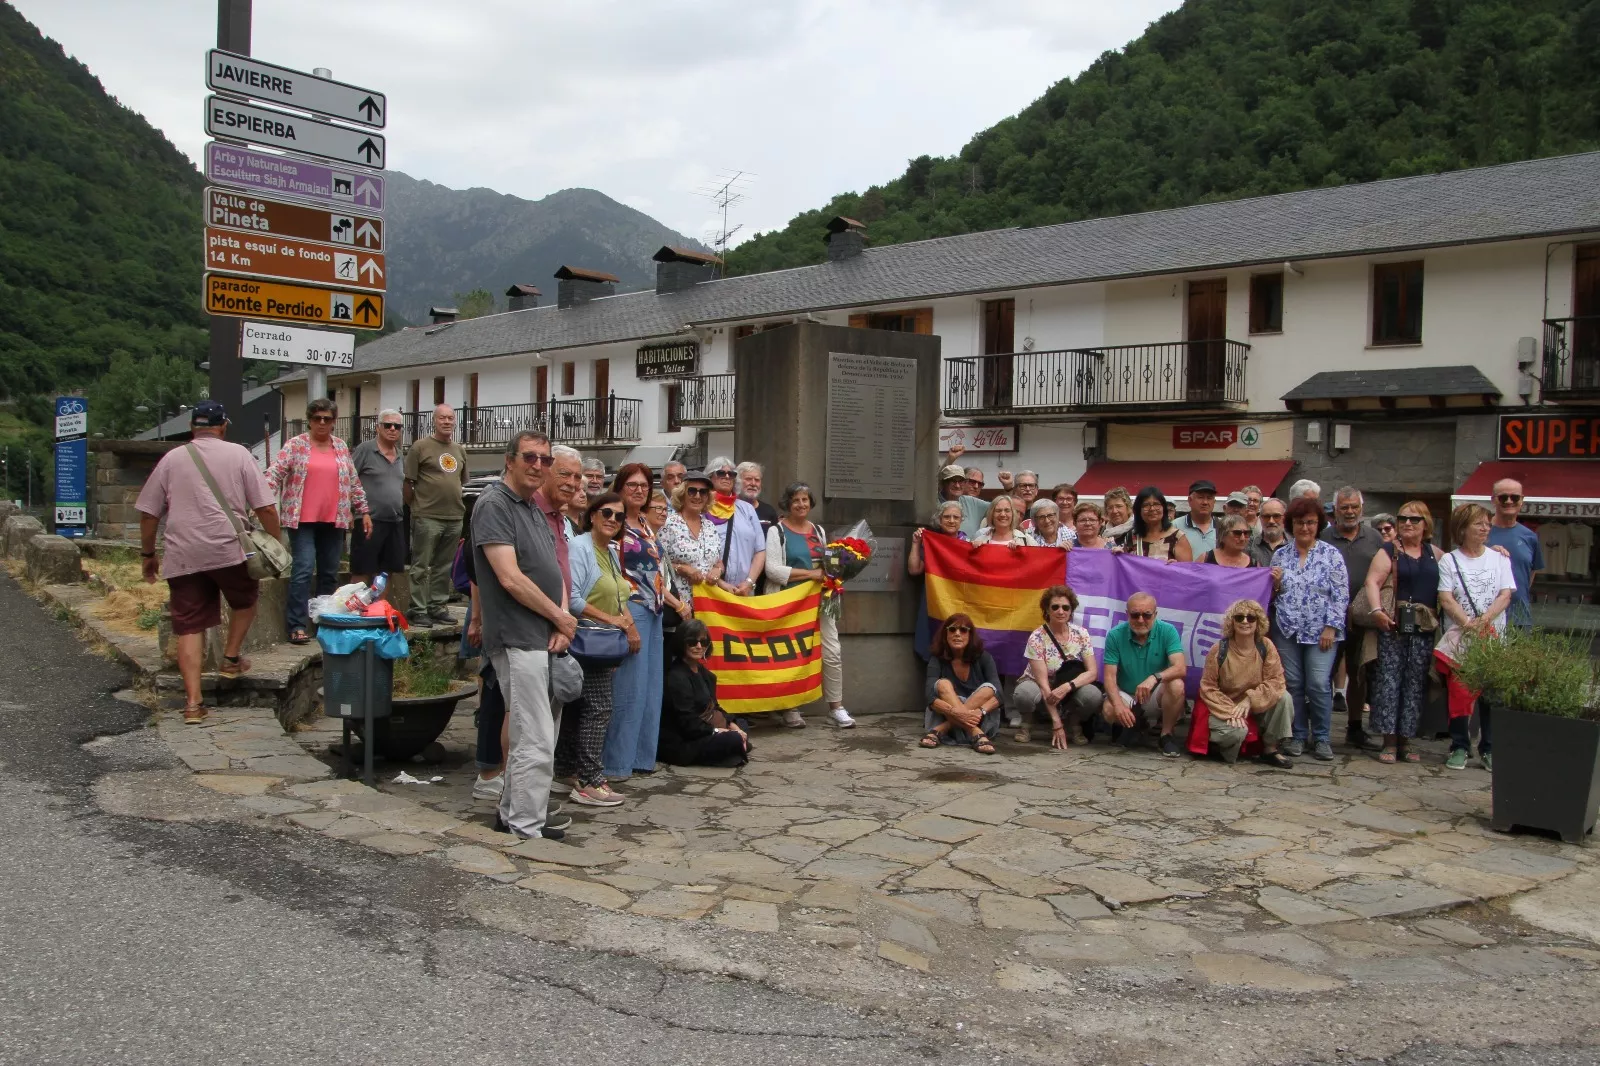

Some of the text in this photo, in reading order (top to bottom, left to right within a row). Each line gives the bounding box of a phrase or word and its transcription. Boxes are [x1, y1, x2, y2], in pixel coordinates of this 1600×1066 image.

[216, 63, 292, 95] JAVIERRE
[214, 108, 296, 140] ESPIERBA
[214, 150, 297, 175] Arte y Naturaleza
[214, 165, 329, 195] Escultura Siajh Armajani
[213, 193, 265, 212] Valle de
[212, 207, 269, 230] Pineta
[210, 235, 240, 249] pista
[281, 246, 295, 256] de
[299, 248, 331, 262] fondo
[210, 250, 251, 266] 14 Km
[212, 280, 260, 294] parador
[212, 293, 323, 318] Monte Perdido
[246, 328, 292, 341] Cerrado
[252, 344, 290, 357] hasta
[638, 346, 694, 364] HABITACIONES
[972, 429, 1008, 448] La Vita
[1179, 430, 1233, 443] SPAR
